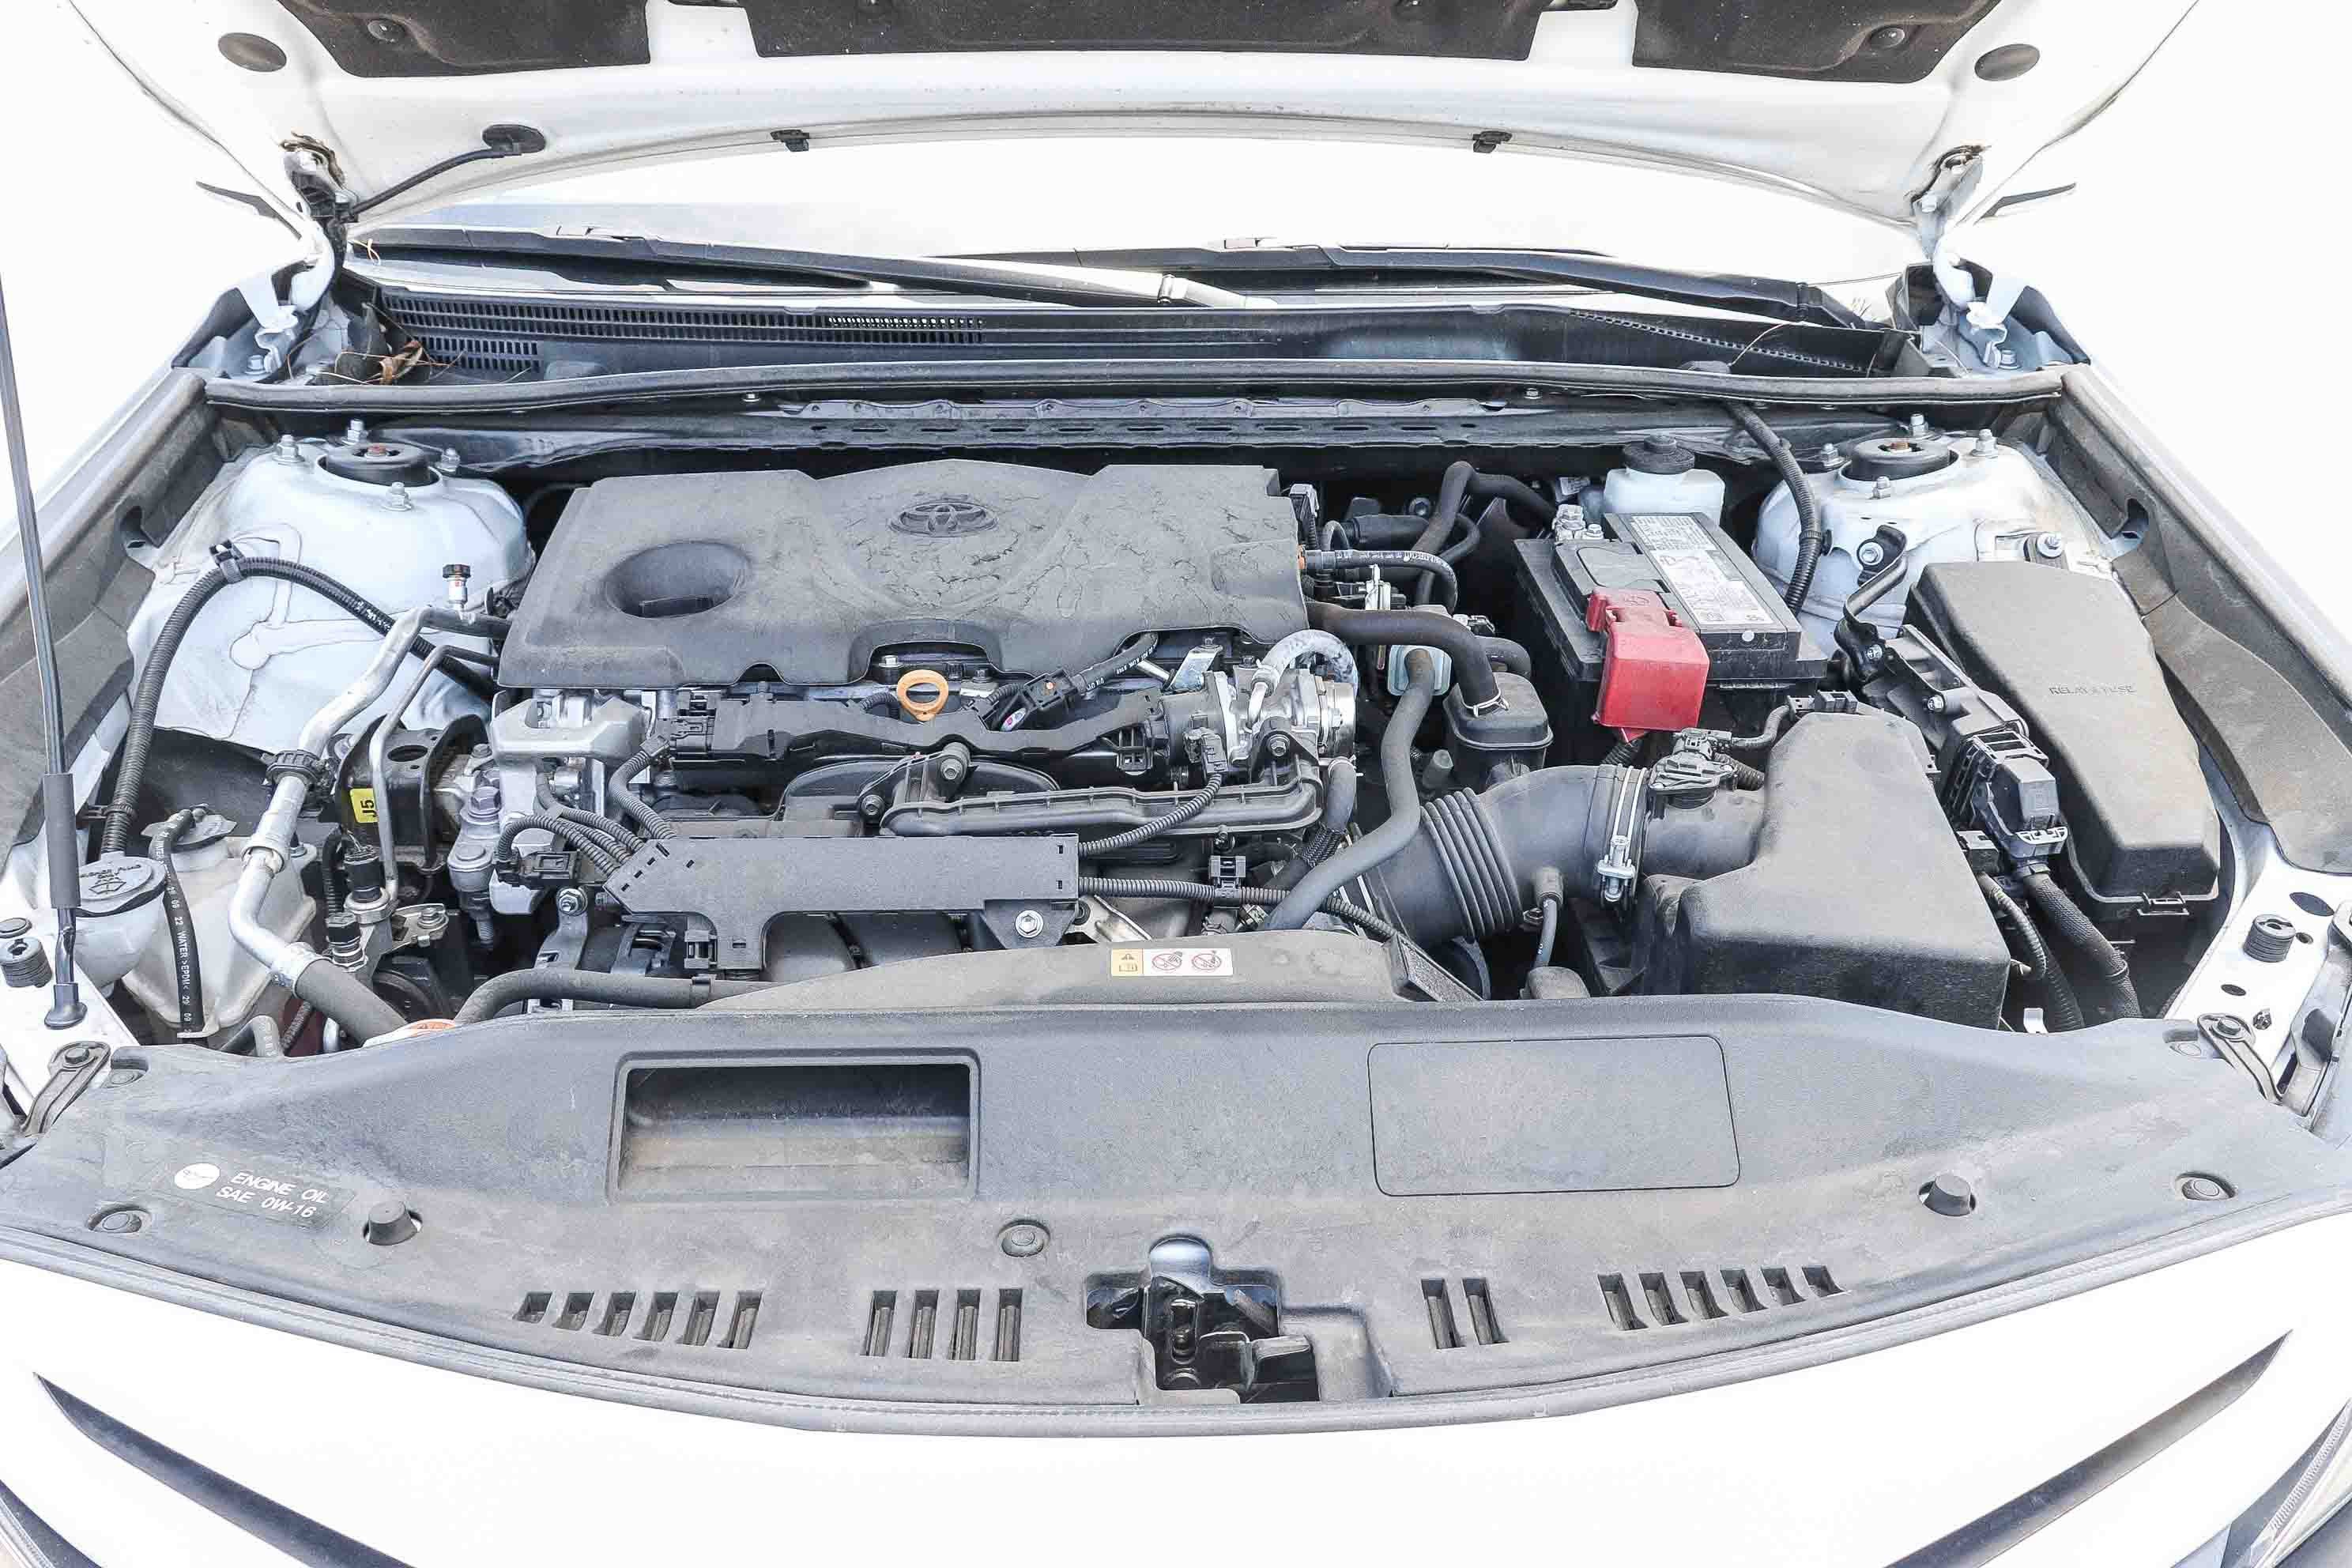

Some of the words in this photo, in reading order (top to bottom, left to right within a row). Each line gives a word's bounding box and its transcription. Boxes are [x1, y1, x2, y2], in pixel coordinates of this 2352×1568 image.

[360, 799, 377, 817] J5
[174, 916, 183, 925] 22
[176, 930, 188, 958] WATER
[216, 1186, 255, 1203] SAE
[261, 1197, 317, 1217] 0W-16
[231, 1172, 296, 1194] ENGINE
[301, 1189, 329, 1203] OIL
